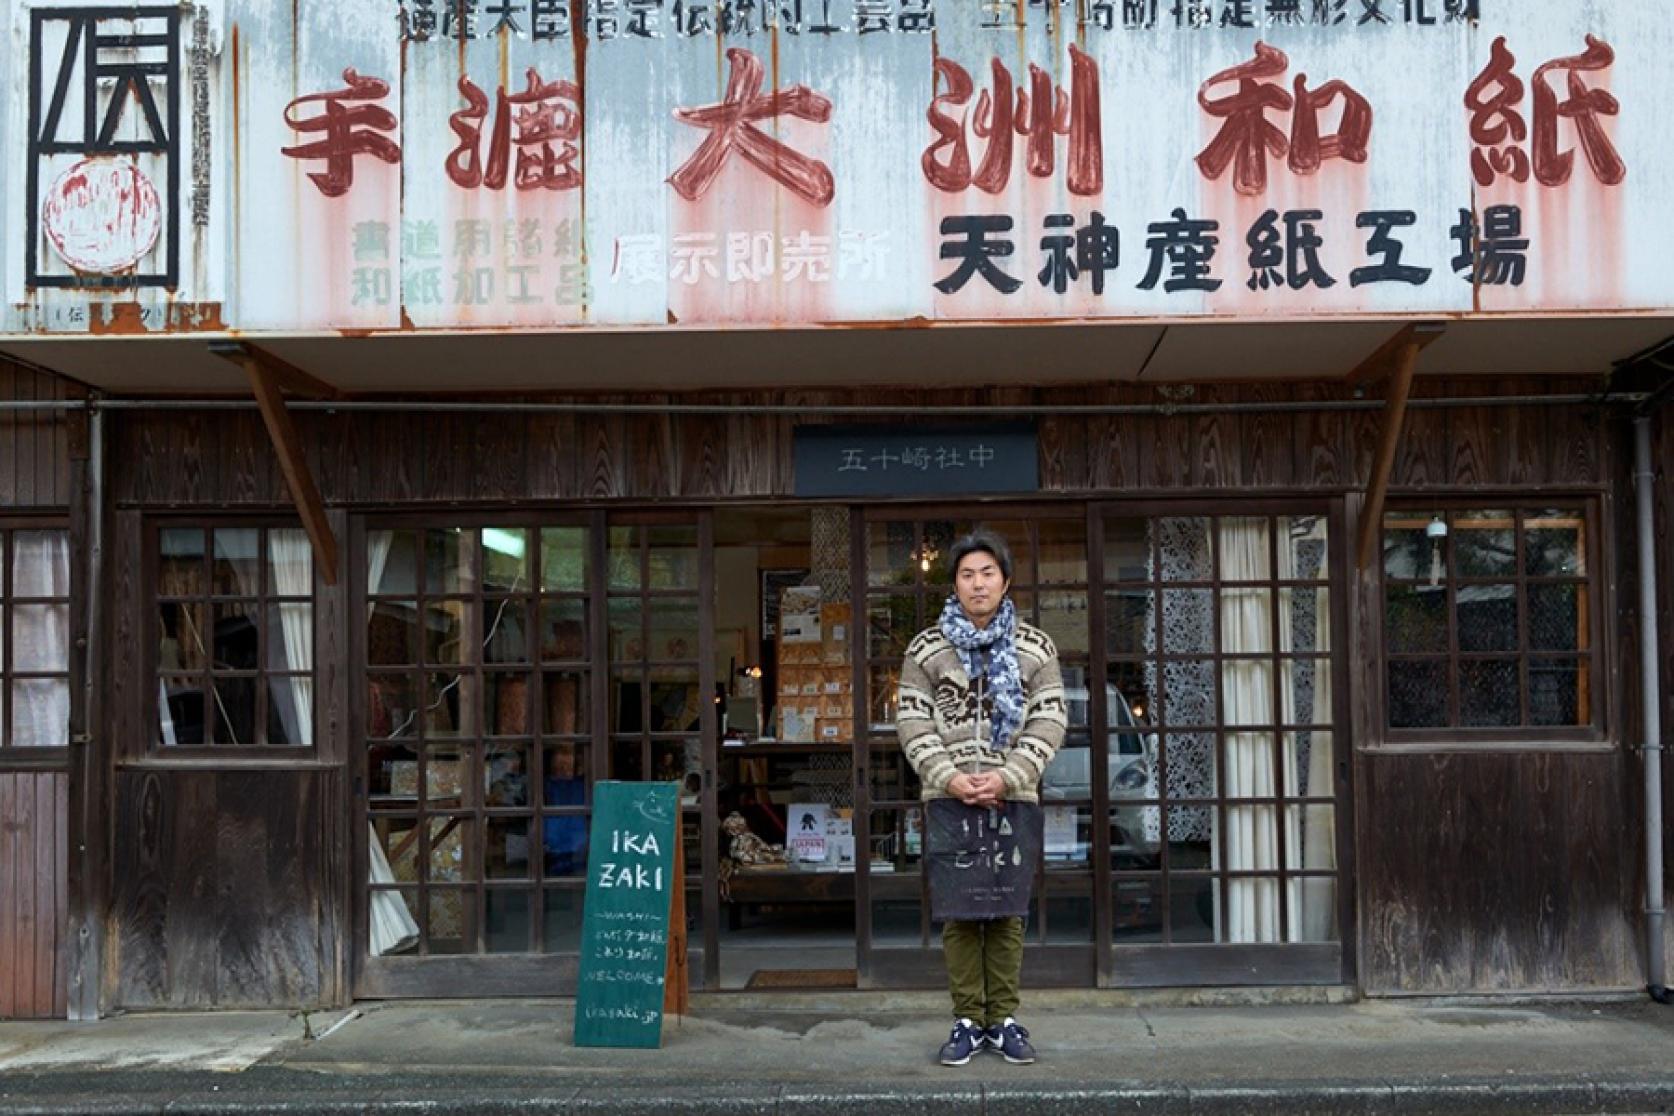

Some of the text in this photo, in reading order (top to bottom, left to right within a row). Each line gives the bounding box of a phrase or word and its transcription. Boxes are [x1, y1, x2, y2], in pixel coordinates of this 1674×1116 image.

[610, 230, 892, 283] 展示即売所
[933, 205, 1531, 295] 天神産紙工場
[837, 443, 995, 472] 五十崎社中
[612, 829, 660, 857] IKA
